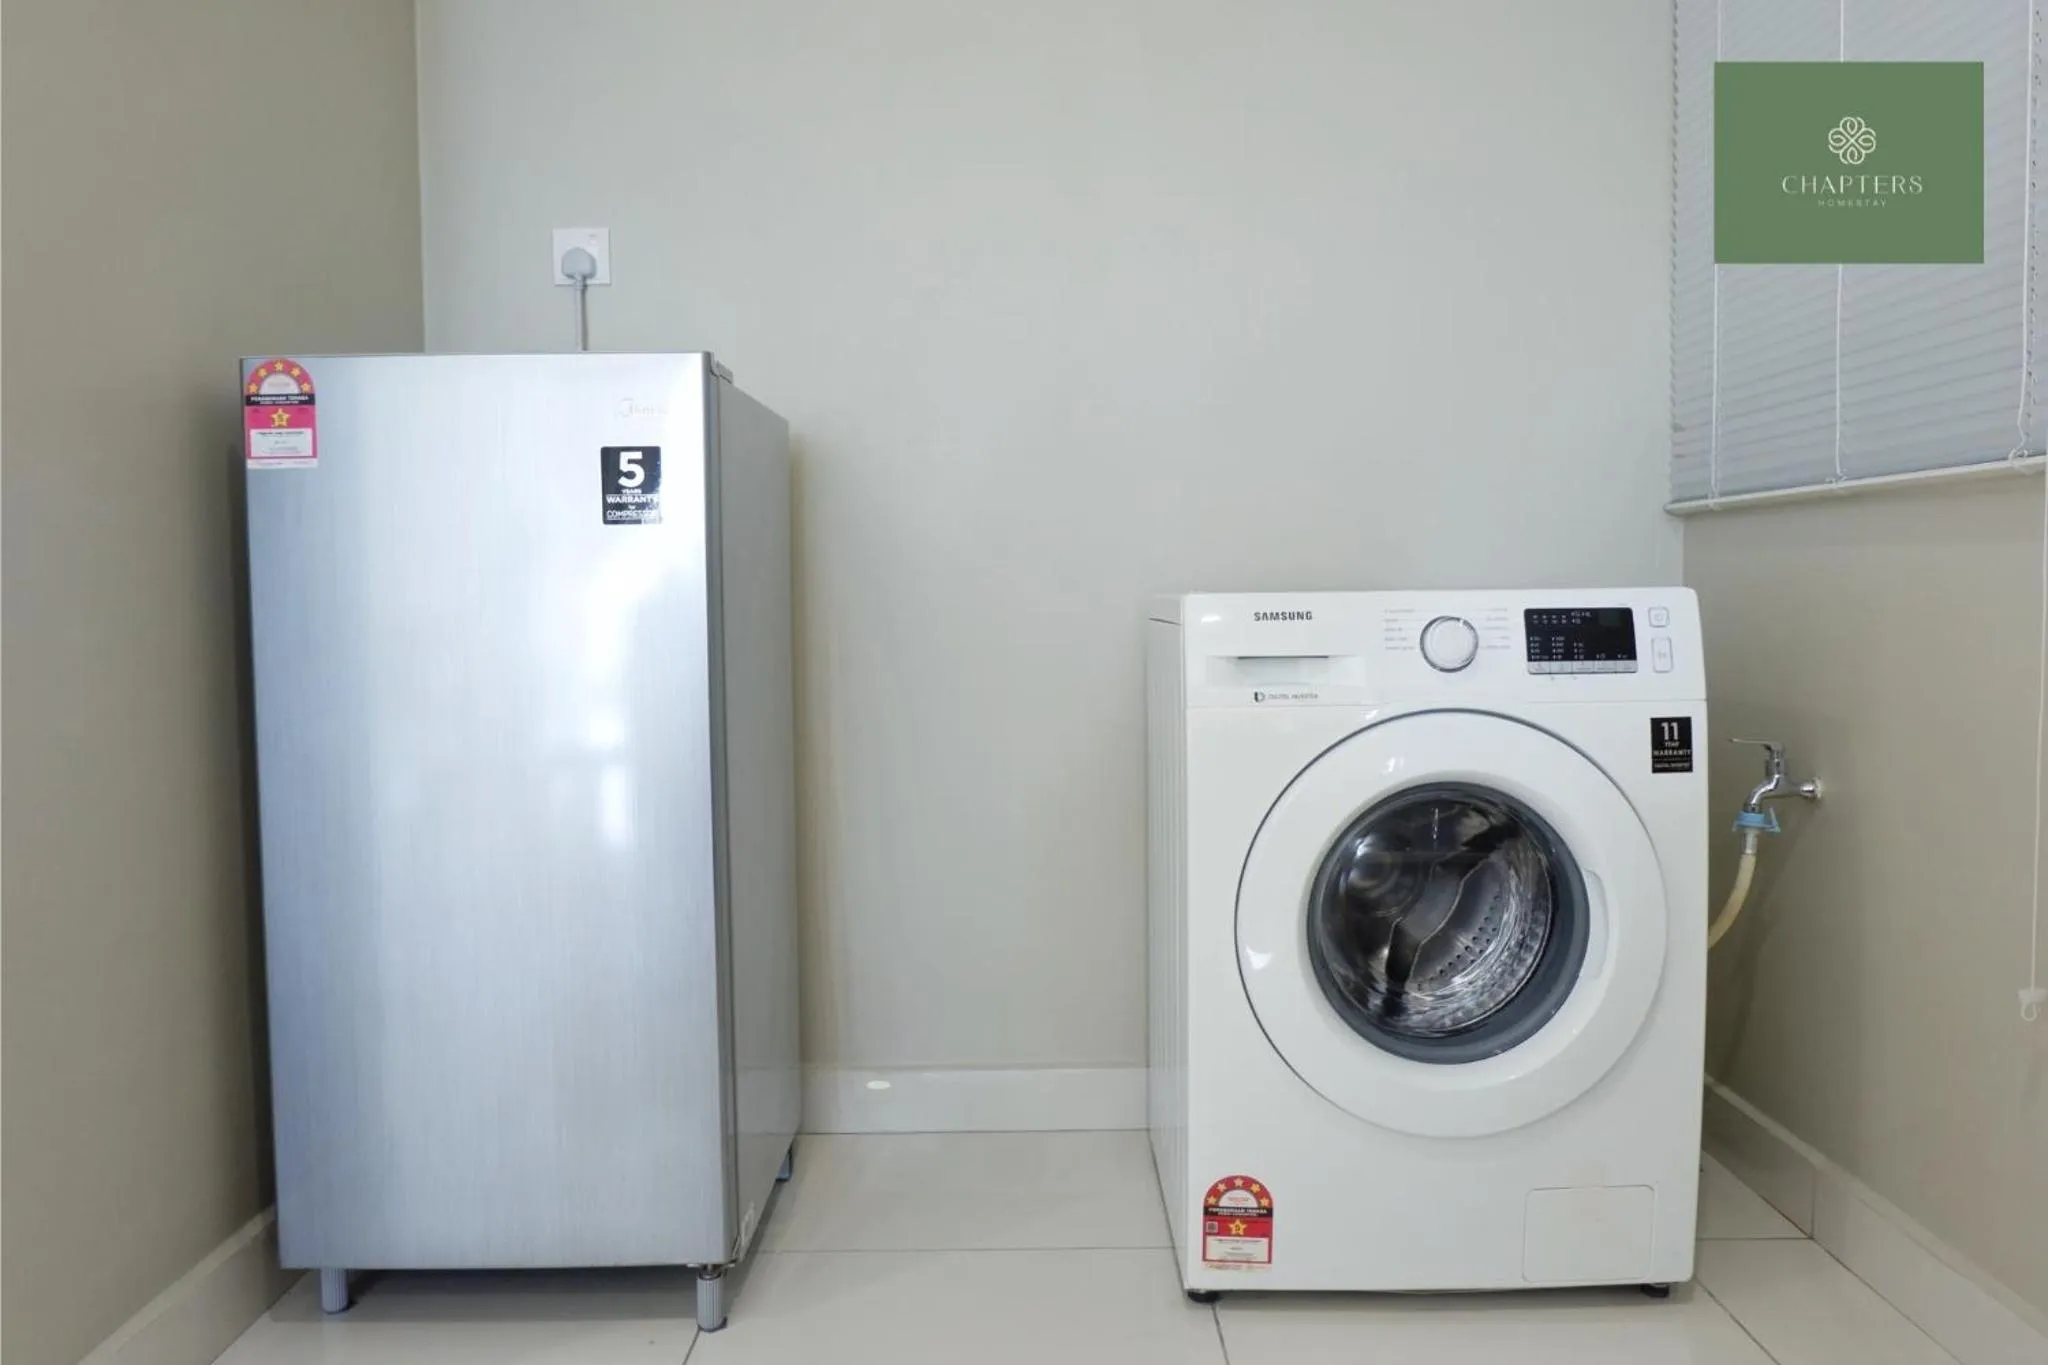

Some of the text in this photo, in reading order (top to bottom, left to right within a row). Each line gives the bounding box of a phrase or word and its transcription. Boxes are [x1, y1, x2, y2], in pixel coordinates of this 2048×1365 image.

[618, 451, 645, 488] 5
[606, 494, 659, 503] WARRANTY
[1253, 611, 1313, 621] SAMSUNG
[1661, 722, 1679, 740] 11
